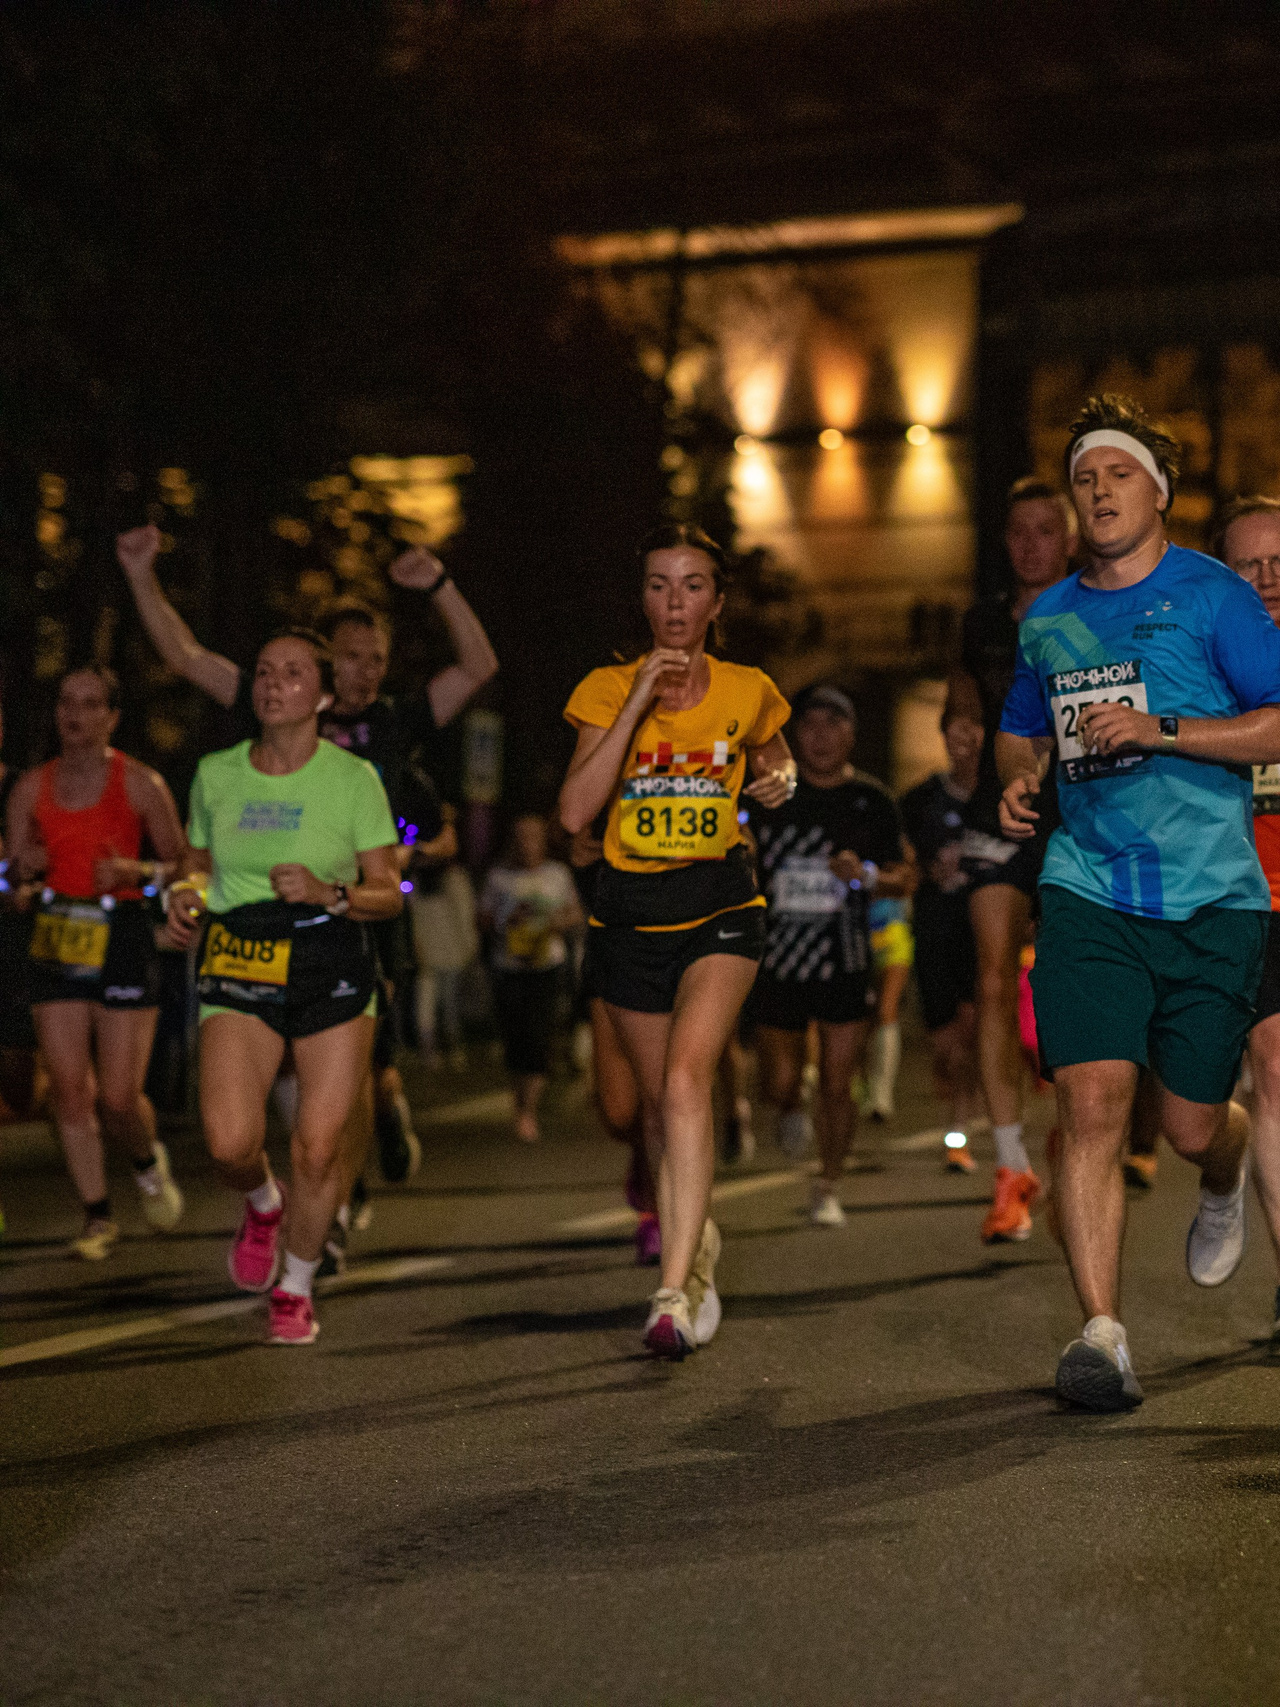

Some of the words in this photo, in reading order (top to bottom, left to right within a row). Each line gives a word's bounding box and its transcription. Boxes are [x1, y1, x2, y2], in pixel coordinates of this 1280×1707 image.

[1131, 632, 1153, 640] RUN
[1133, 623, 1178, 632] RESPECT
[636, 806, 718, 838] 8138
[211, 930, 275, 963] 6408
